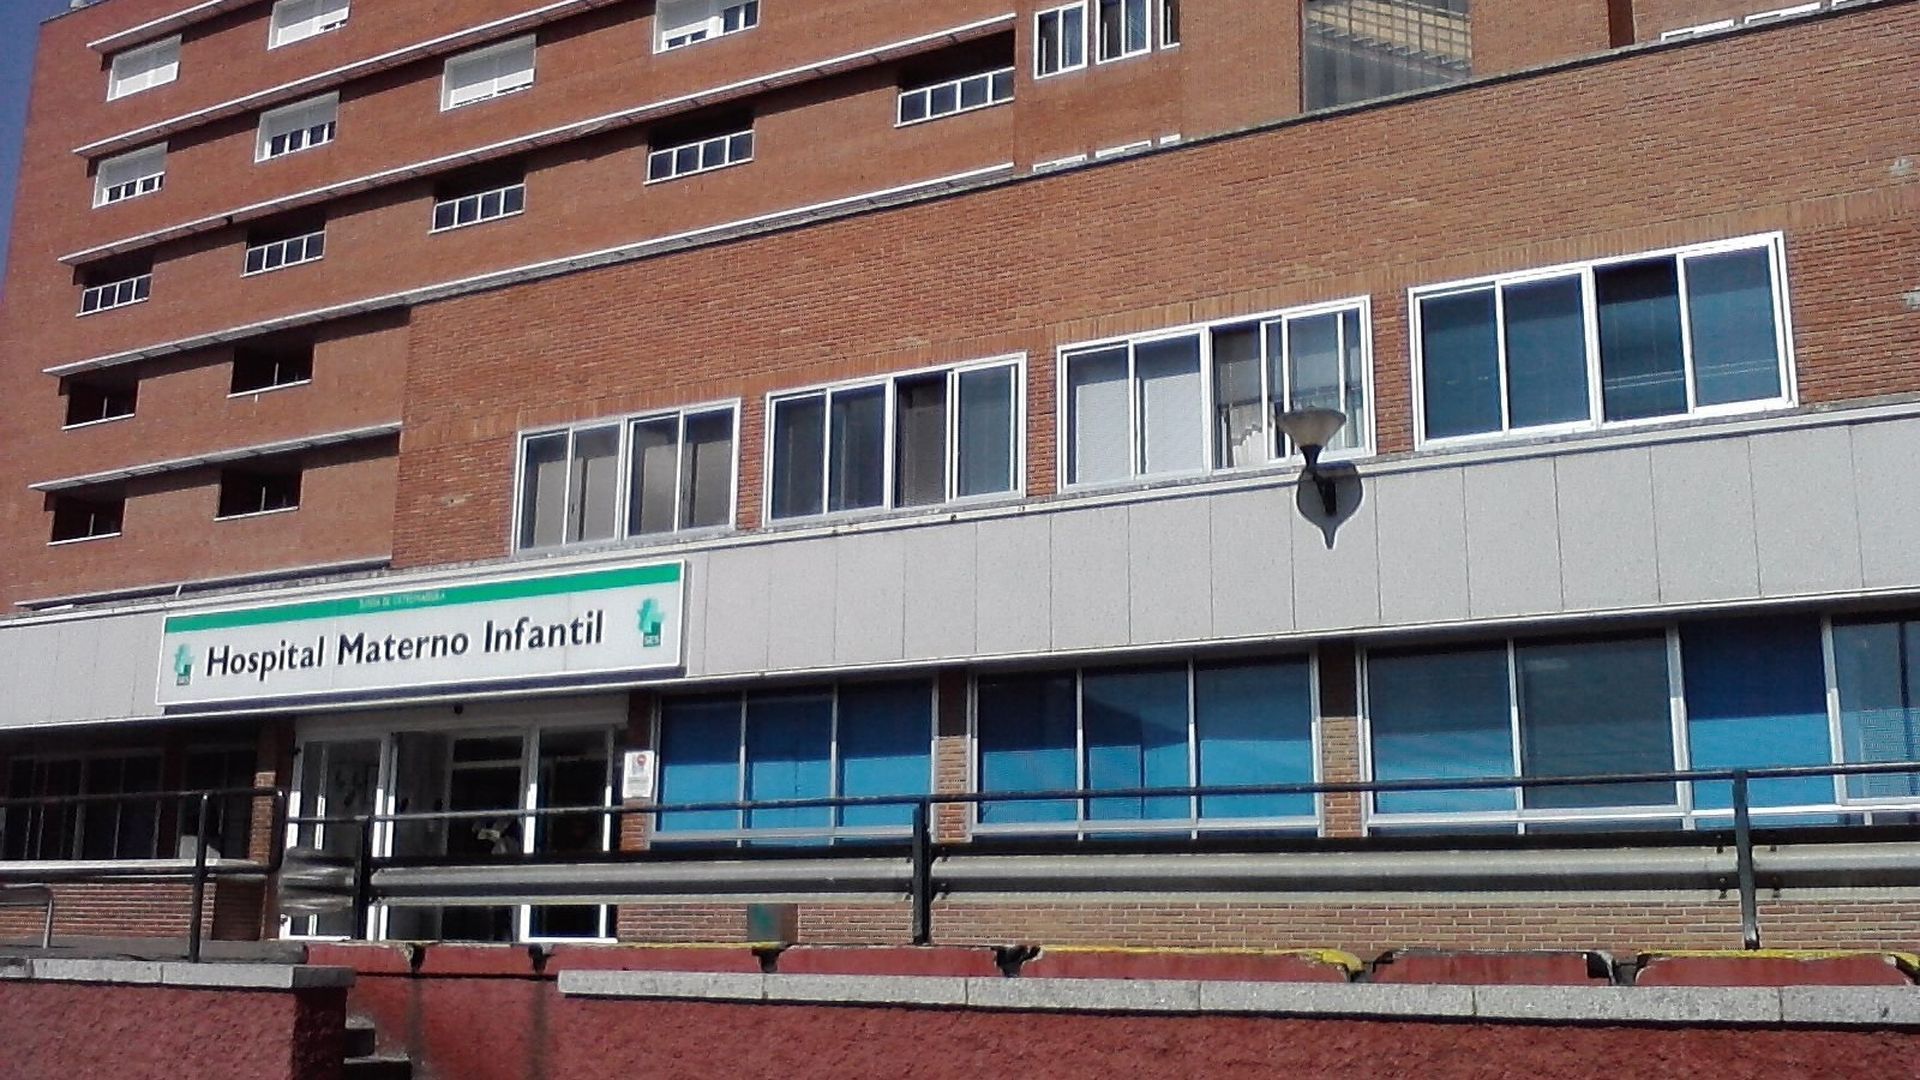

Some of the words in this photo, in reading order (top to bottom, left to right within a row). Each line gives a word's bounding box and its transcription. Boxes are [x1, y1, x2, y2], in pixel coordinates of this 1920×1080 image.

[206, 635, 325, 682] Hospital
[337, 632, 469, 665] Materno
[484, 610, 603, 653] Infantil
